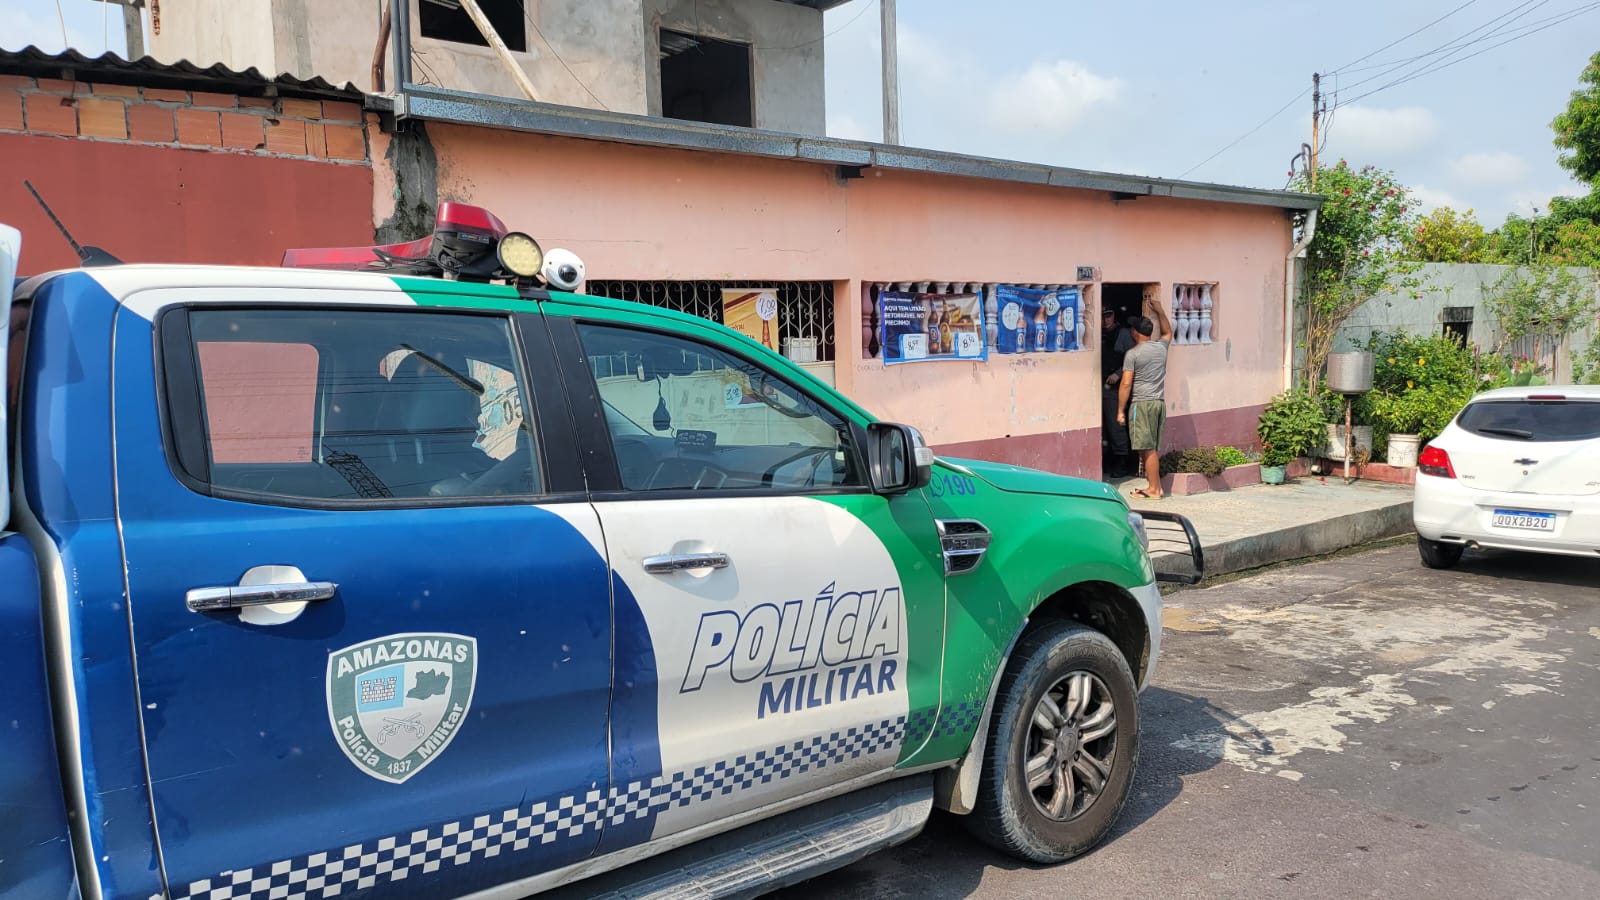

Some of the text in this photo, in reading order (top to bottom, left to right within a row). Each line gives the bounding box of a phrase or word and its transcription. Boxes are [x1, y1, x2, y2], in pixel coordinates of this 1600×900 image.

[337, 639, 468, 679] AMAZONAS
[679, 581, 900, 694] POLÍCIA
[757, 659, 898, 720] MILITAR
[387, 760, 412, 775] 1837
[416, 702, 464, 760] Militar
